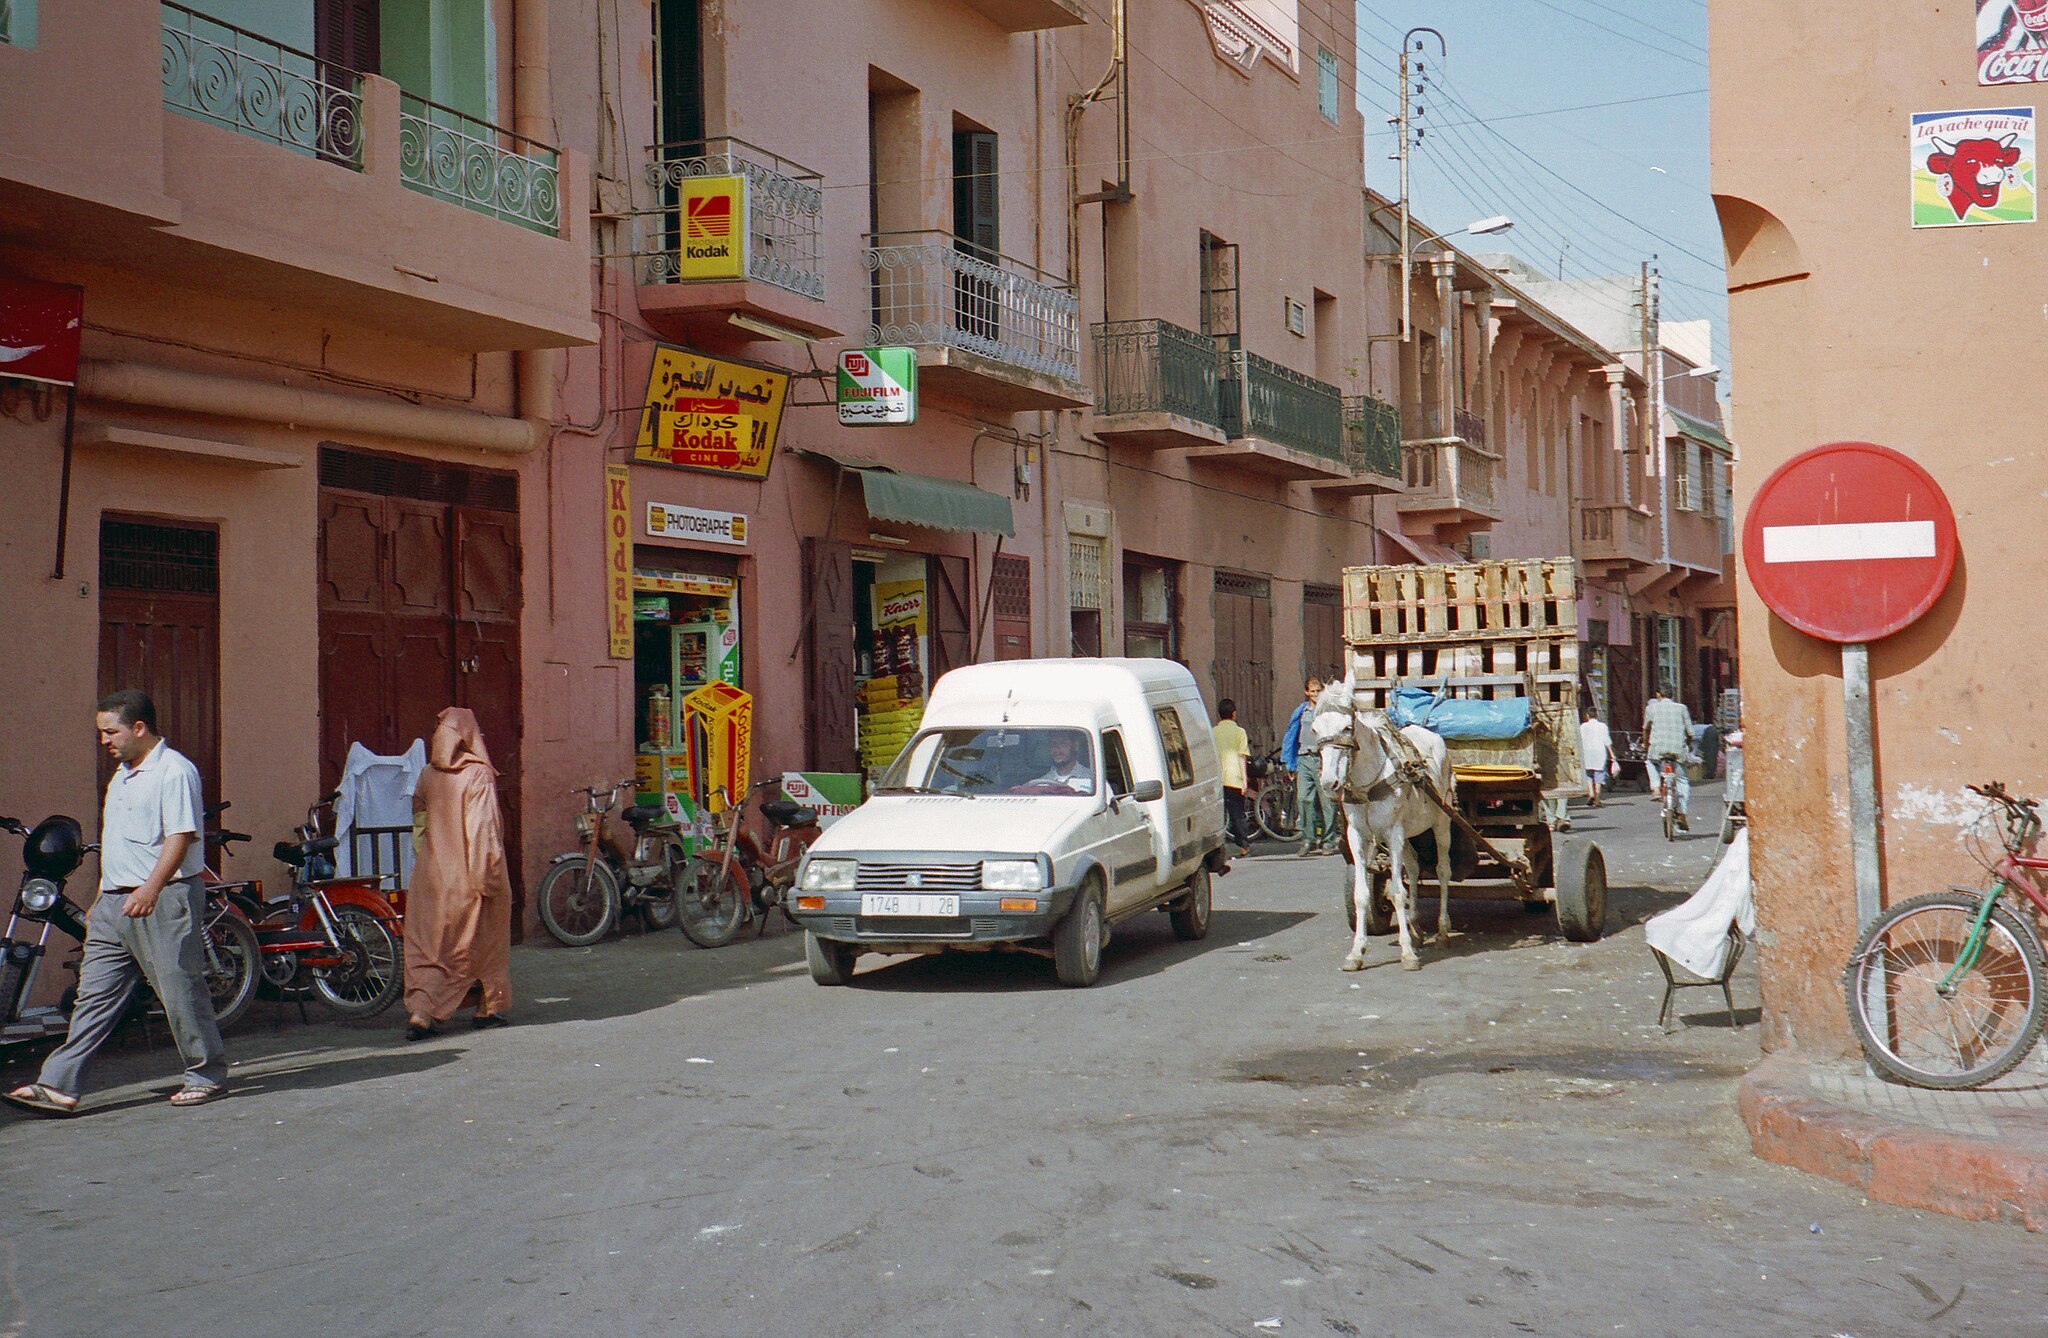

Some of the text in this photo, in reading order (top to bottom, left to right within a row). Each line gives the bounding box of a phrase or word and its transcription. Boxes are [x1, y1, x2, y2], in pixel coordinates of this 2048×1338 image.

[1938, 117, 1982, 132] vache
[1984, 117, 2010, 132] qui
[2011, 118, 2030, 132] rit
[687, 245, 729, 259] Kodak
[844, 387, 901, 398] FUJIFILM
[673, 413, 738, 431] كوداك
[673, 428, 738, 450] Kodak
[667, 512, 730, 536] PHOTOGRAPHE
[610, 479, 629, 634] Kodak
[883, 598, 921, 617] Knorr
[690, 696, 718, 713] Kodak
[736, 701, 751, 801] Kodachrome
[870, 896, 899, 914] 1748
